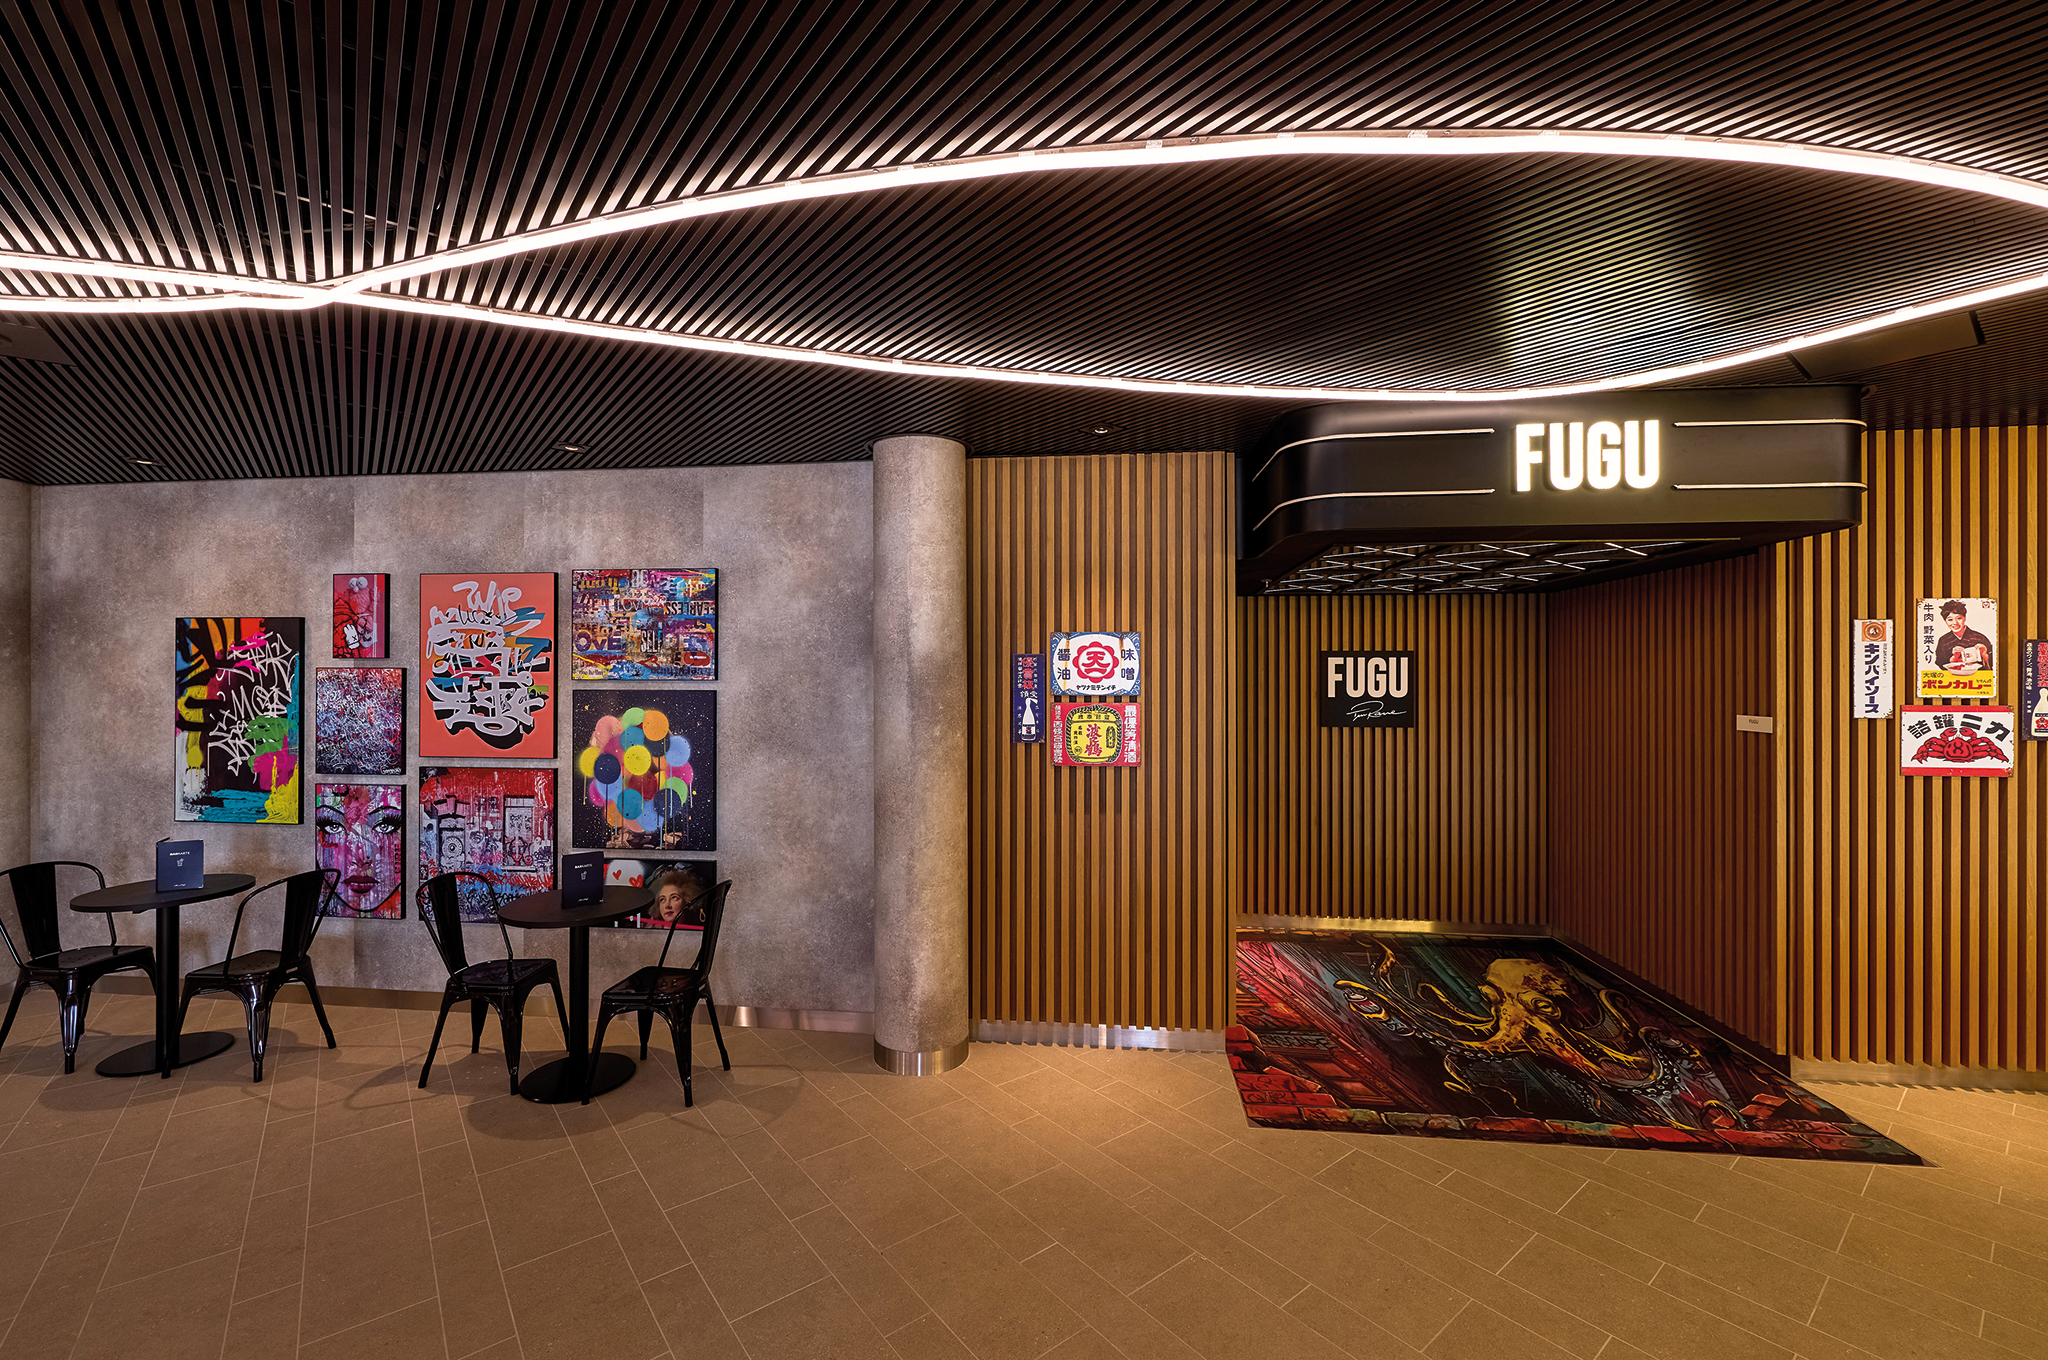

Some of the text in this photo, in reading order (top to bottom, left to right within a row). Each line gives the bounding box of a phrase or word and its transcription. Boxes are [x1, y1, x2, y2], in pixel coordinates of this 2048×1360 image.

[1515, 419, 1660, 492] FUGU
[1923, 603, 1934, 622] 牛肉
[1327, 656, 1409, 698] FUGU
[1923, 680, 1992, 690] ボンカレー
